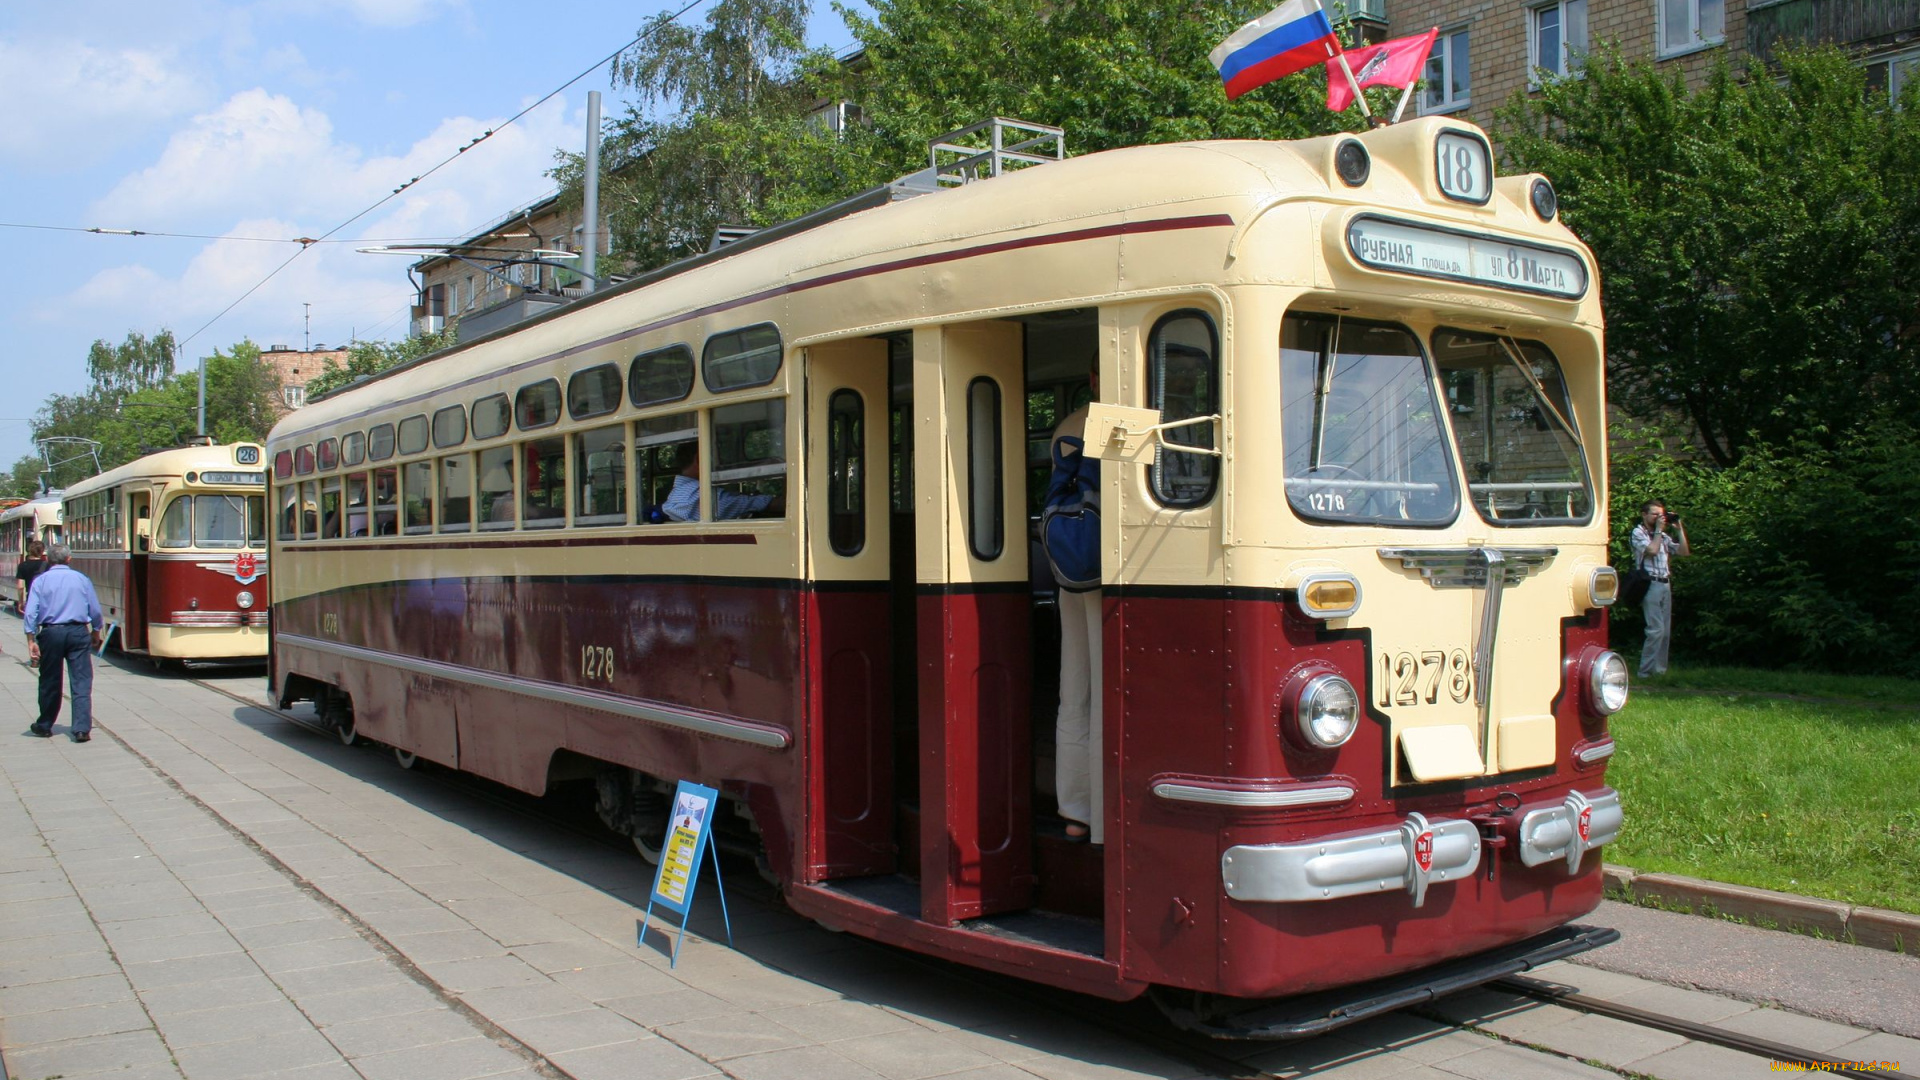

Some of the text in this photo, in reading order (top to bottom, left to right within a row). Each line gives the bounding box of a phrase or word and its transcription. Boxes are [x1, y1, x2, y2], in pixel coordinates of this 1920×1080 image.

[1442, 143, 1473, 193] 18
[1422, 257, 1461, 273] ПЛОЩАДЬ
[1507, 247, 1519, 279] 8
[1522, 257, 1565, 289] МАРТА
[240, 449, 256, 461] 26
[1308, 493, 1345, 511] 1278
[582, 644, 614, 683] 1278
[1379, 648, 1471, 707] 1278
